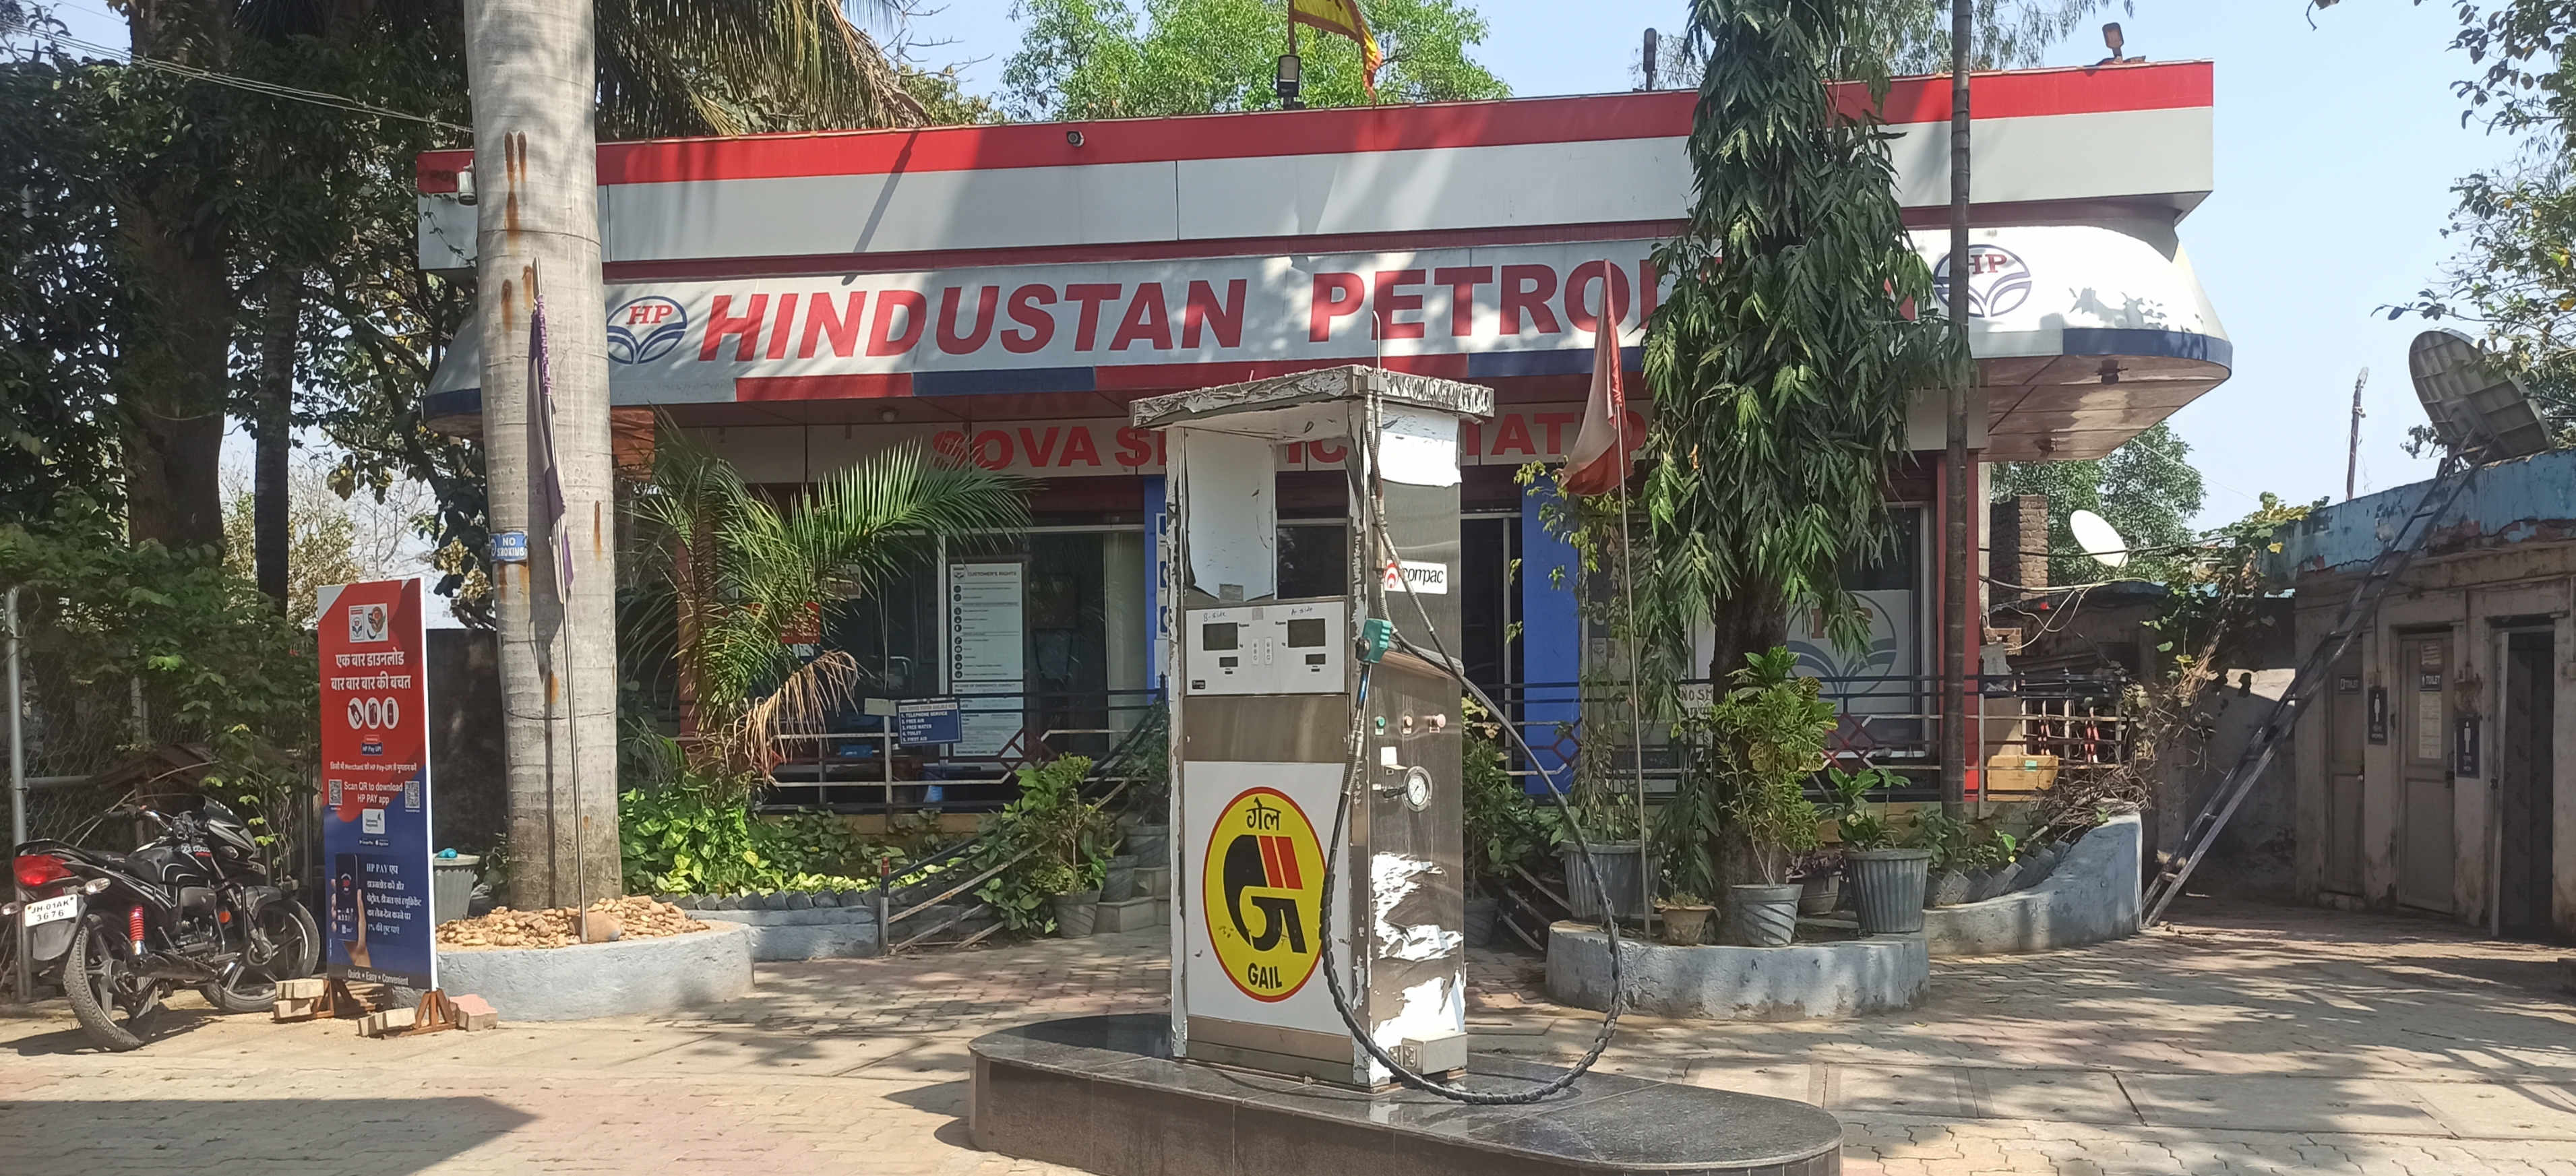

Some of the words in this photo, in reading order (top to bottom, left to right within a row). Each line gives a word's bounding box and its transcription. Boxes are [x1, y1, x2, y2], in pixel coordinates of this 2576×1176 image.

[625, 305, 673, 325] HP
[698, 278, 1246, 362] HINDUSTAN
[930, 425, 1102, 471] SOVA
[502, 537, 516, 547] NO
[335, 654, 350, 669] एक
[366, 646, 404, 667] डाउनलोड
[376, 670, 389, 690] की
[2426, 675, 2441, 685] TOILET
[1681, 689, 1695, 702] NO
[344, 781, 358, 791] Scan
[359, 781, 368, 791] QR
[369, 782, 374, 791] to
[375, 782, 403, 792] download
[357, 794, 366, 803] HP
[366, 794, 378, 803] PAY
[379, 796, 390, 806] app
[1245, 796, 1281, 831] गेल
[366, 863, 375, 873] HP
[375, 863, 388, 873] PAY
[31, 900, 69, 915] JH-01AK
[36, 909, 64, 922] 3676
[347, 968, 361, 979] Quick
[365, 971, 377, 983] Easy
[381, 973, 409, 986] Convenient
[1248, 962, 1283, 989] GAIL
